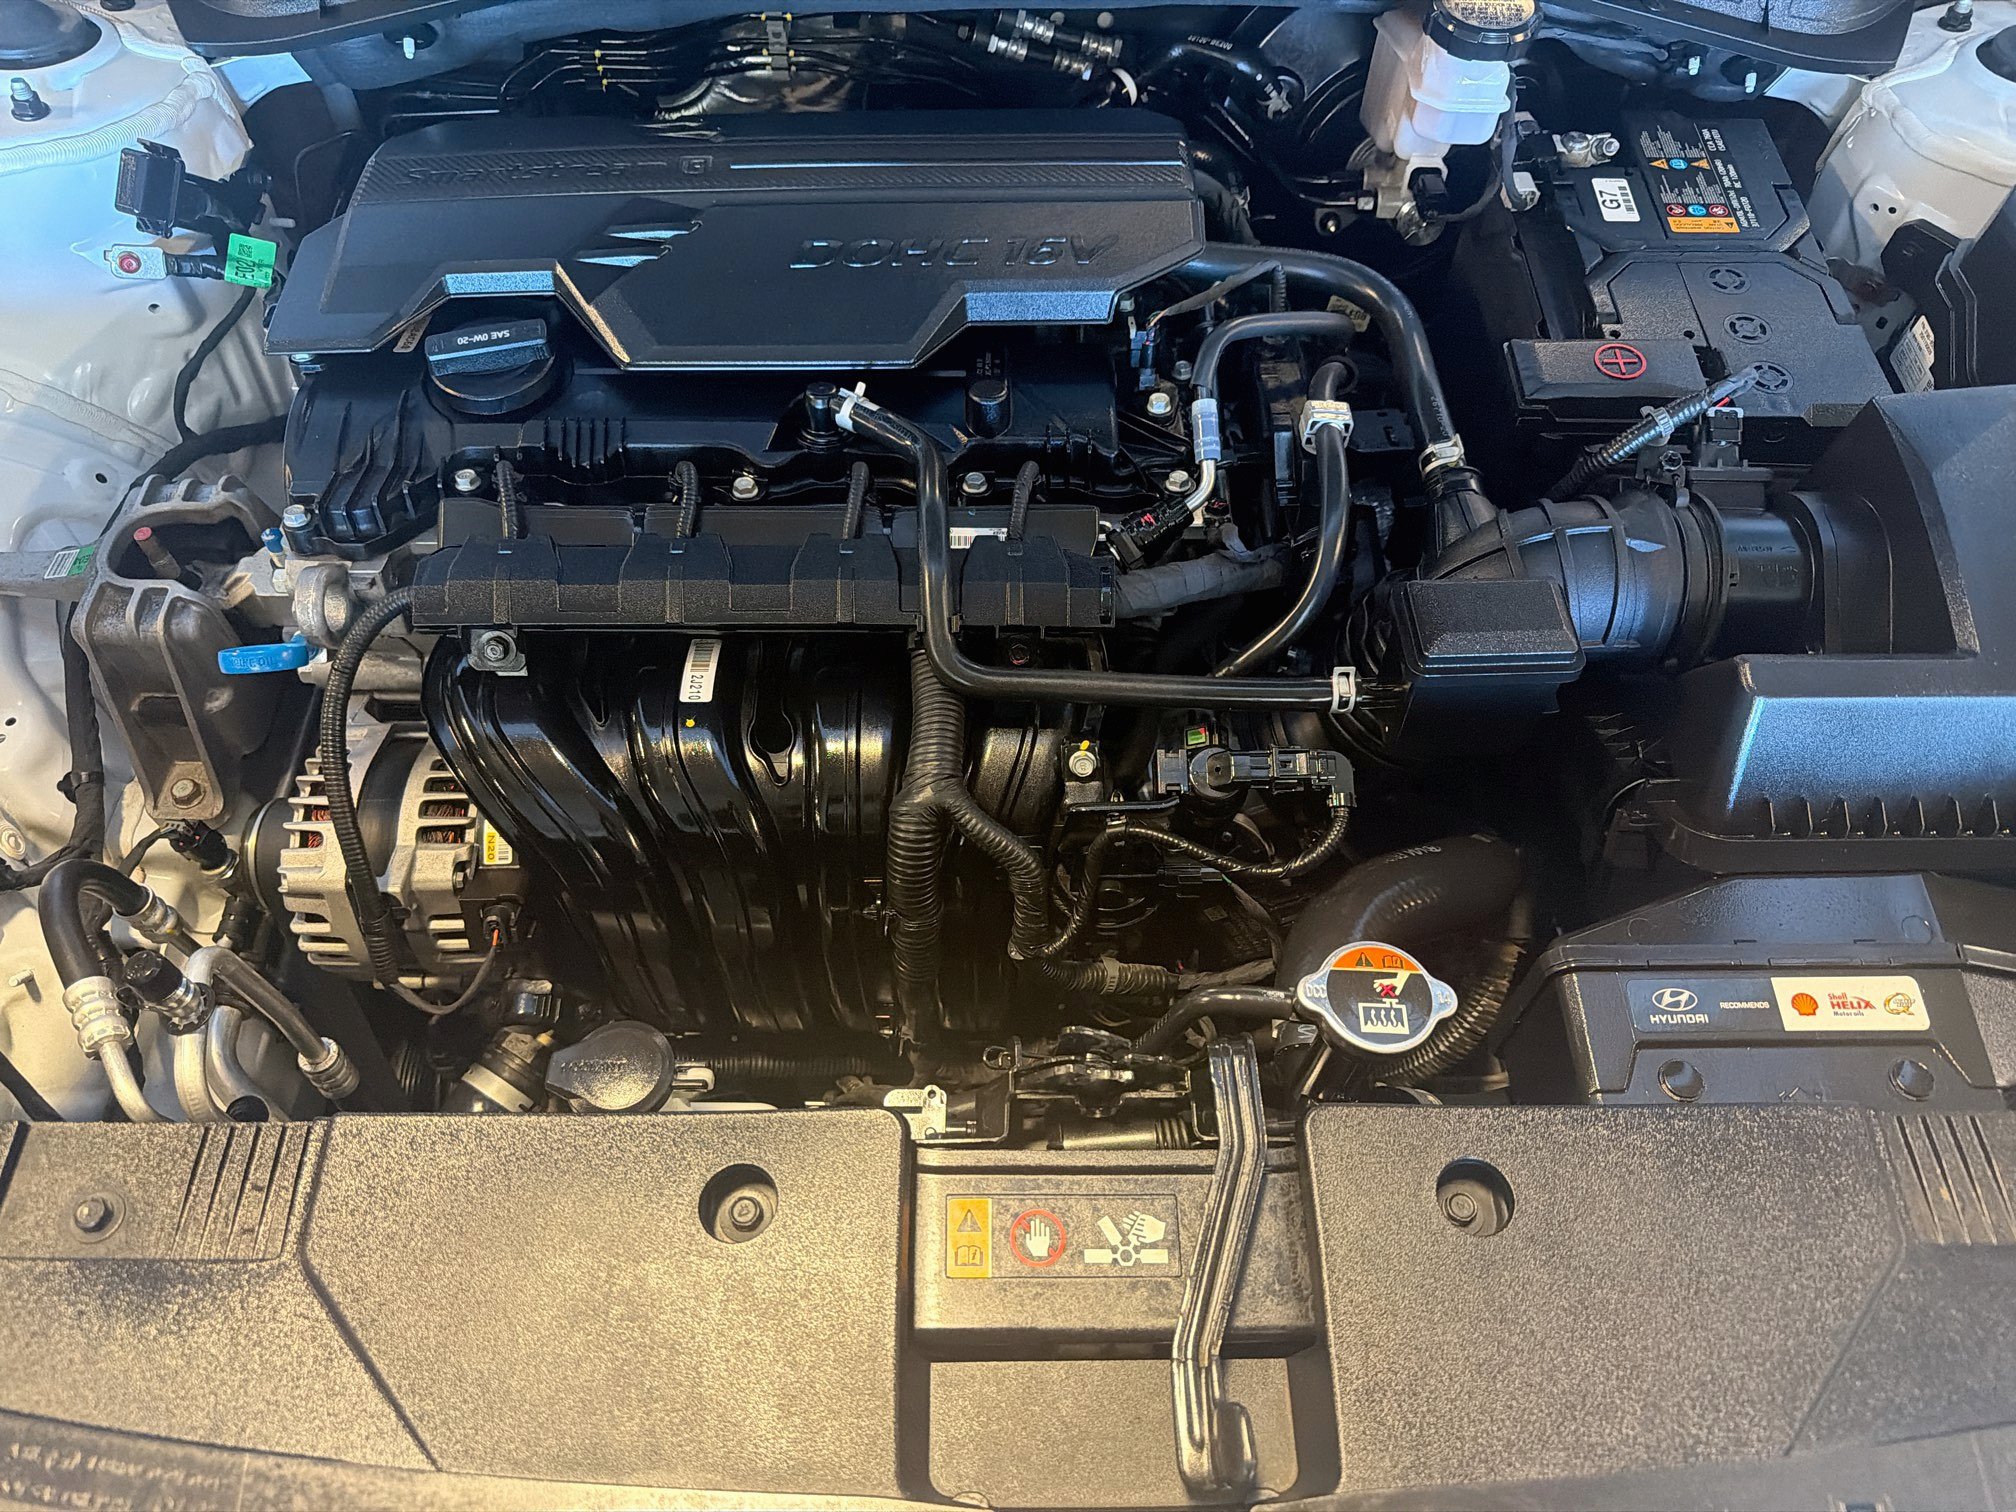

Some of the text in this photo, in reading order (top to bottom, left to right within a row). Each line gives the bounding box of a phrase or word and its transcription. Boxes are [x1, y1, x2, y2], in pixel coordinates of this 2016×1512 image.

[1598, 189, 1622, 210] G7
[789, 236, 1119, 269] DOHC 16V
[456, 328, 511, 346] SAE 0W-20
[687, 674, 704, 701] 2J210
[1827, 992, 1848, 1001] Shell
[1829, 997, 1877, 1010] HELIX
[1719, 1000, 1771, 1010] RECOMMENDS
[1650, 1013, 1710, 1025] HYUNDAI
